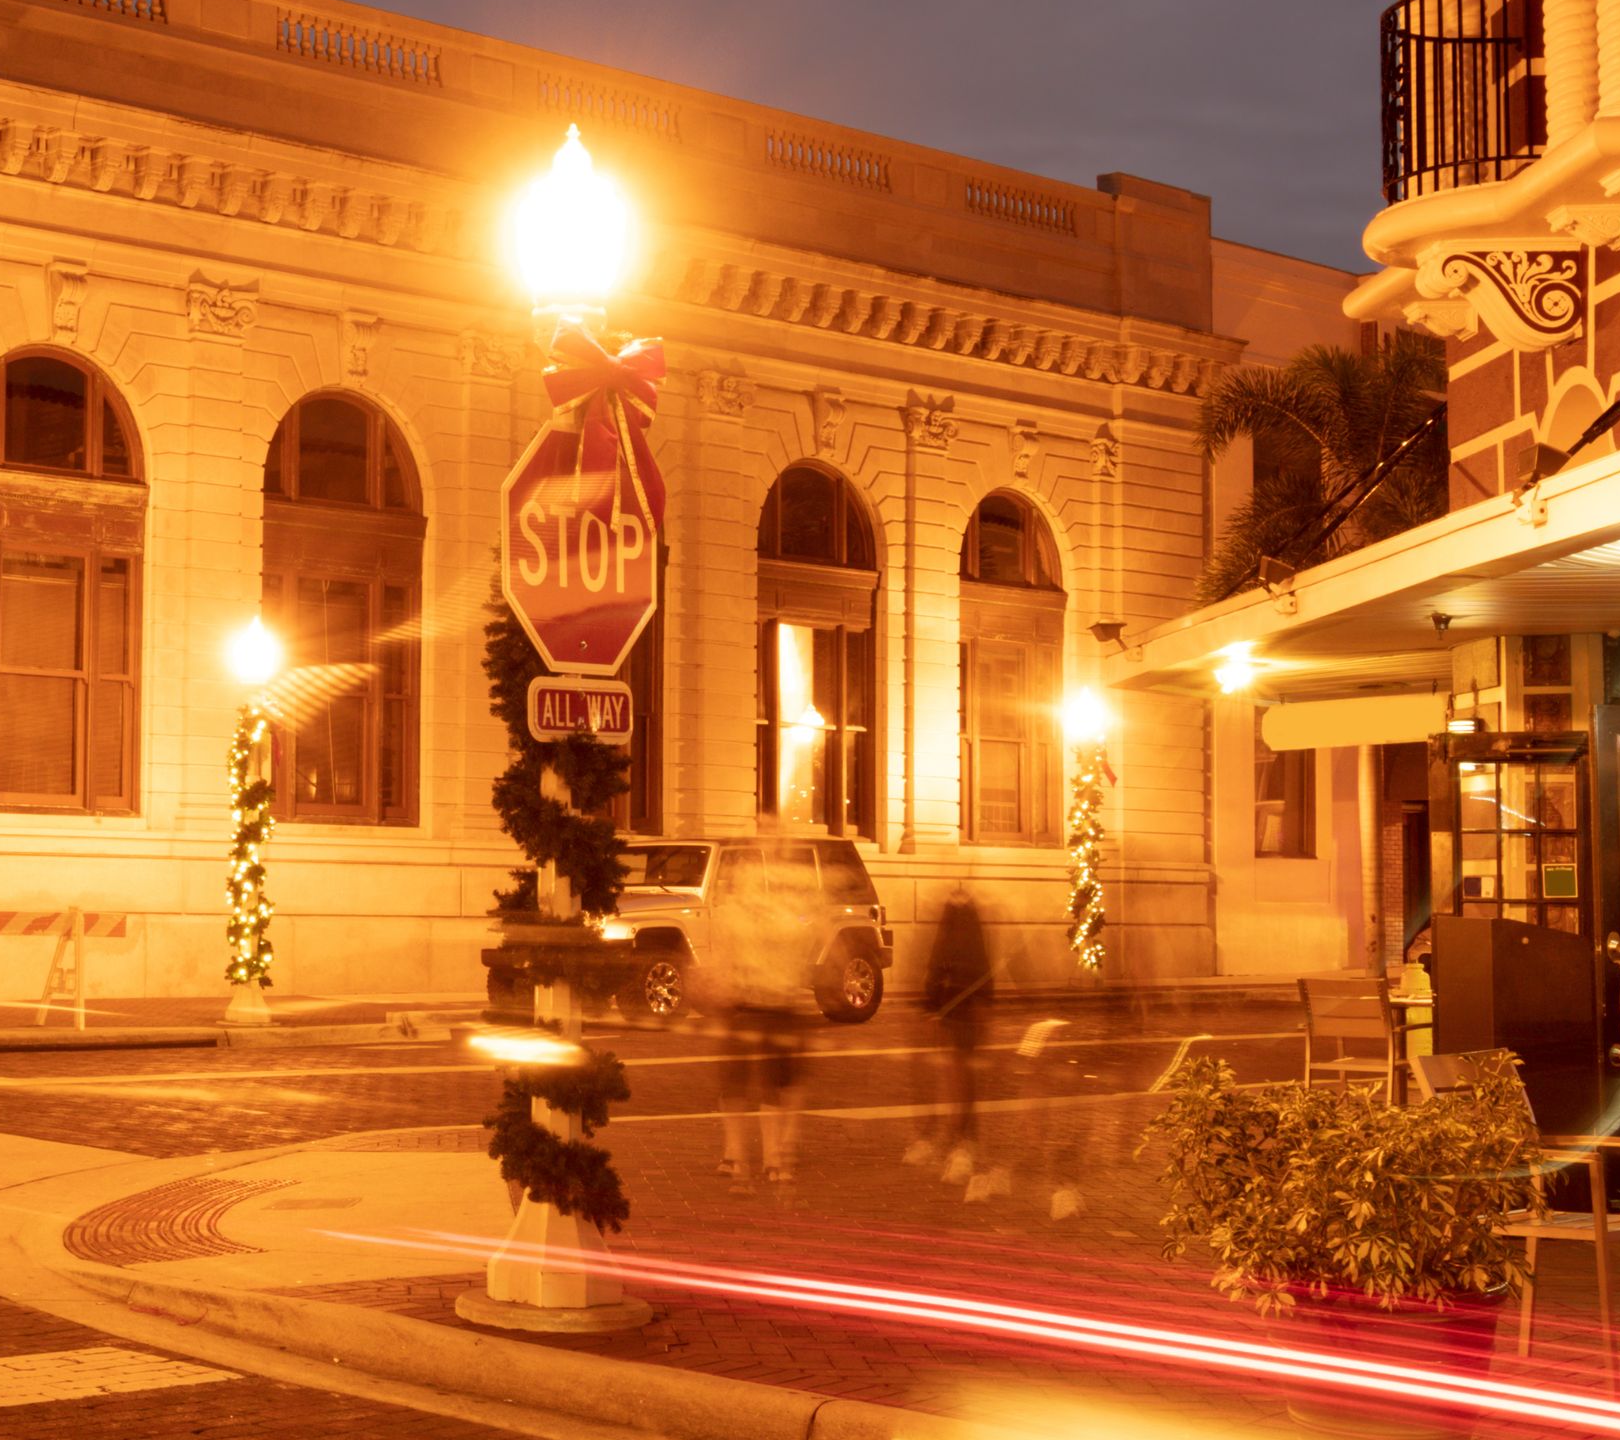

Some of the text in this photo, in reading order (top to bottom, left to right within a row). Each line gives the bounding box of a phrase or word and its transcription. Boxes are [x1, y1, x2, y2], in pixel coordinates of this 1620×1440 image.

[518, 500, 644, 593] STOP
[542, 692, 624, 730] ALL WAY
